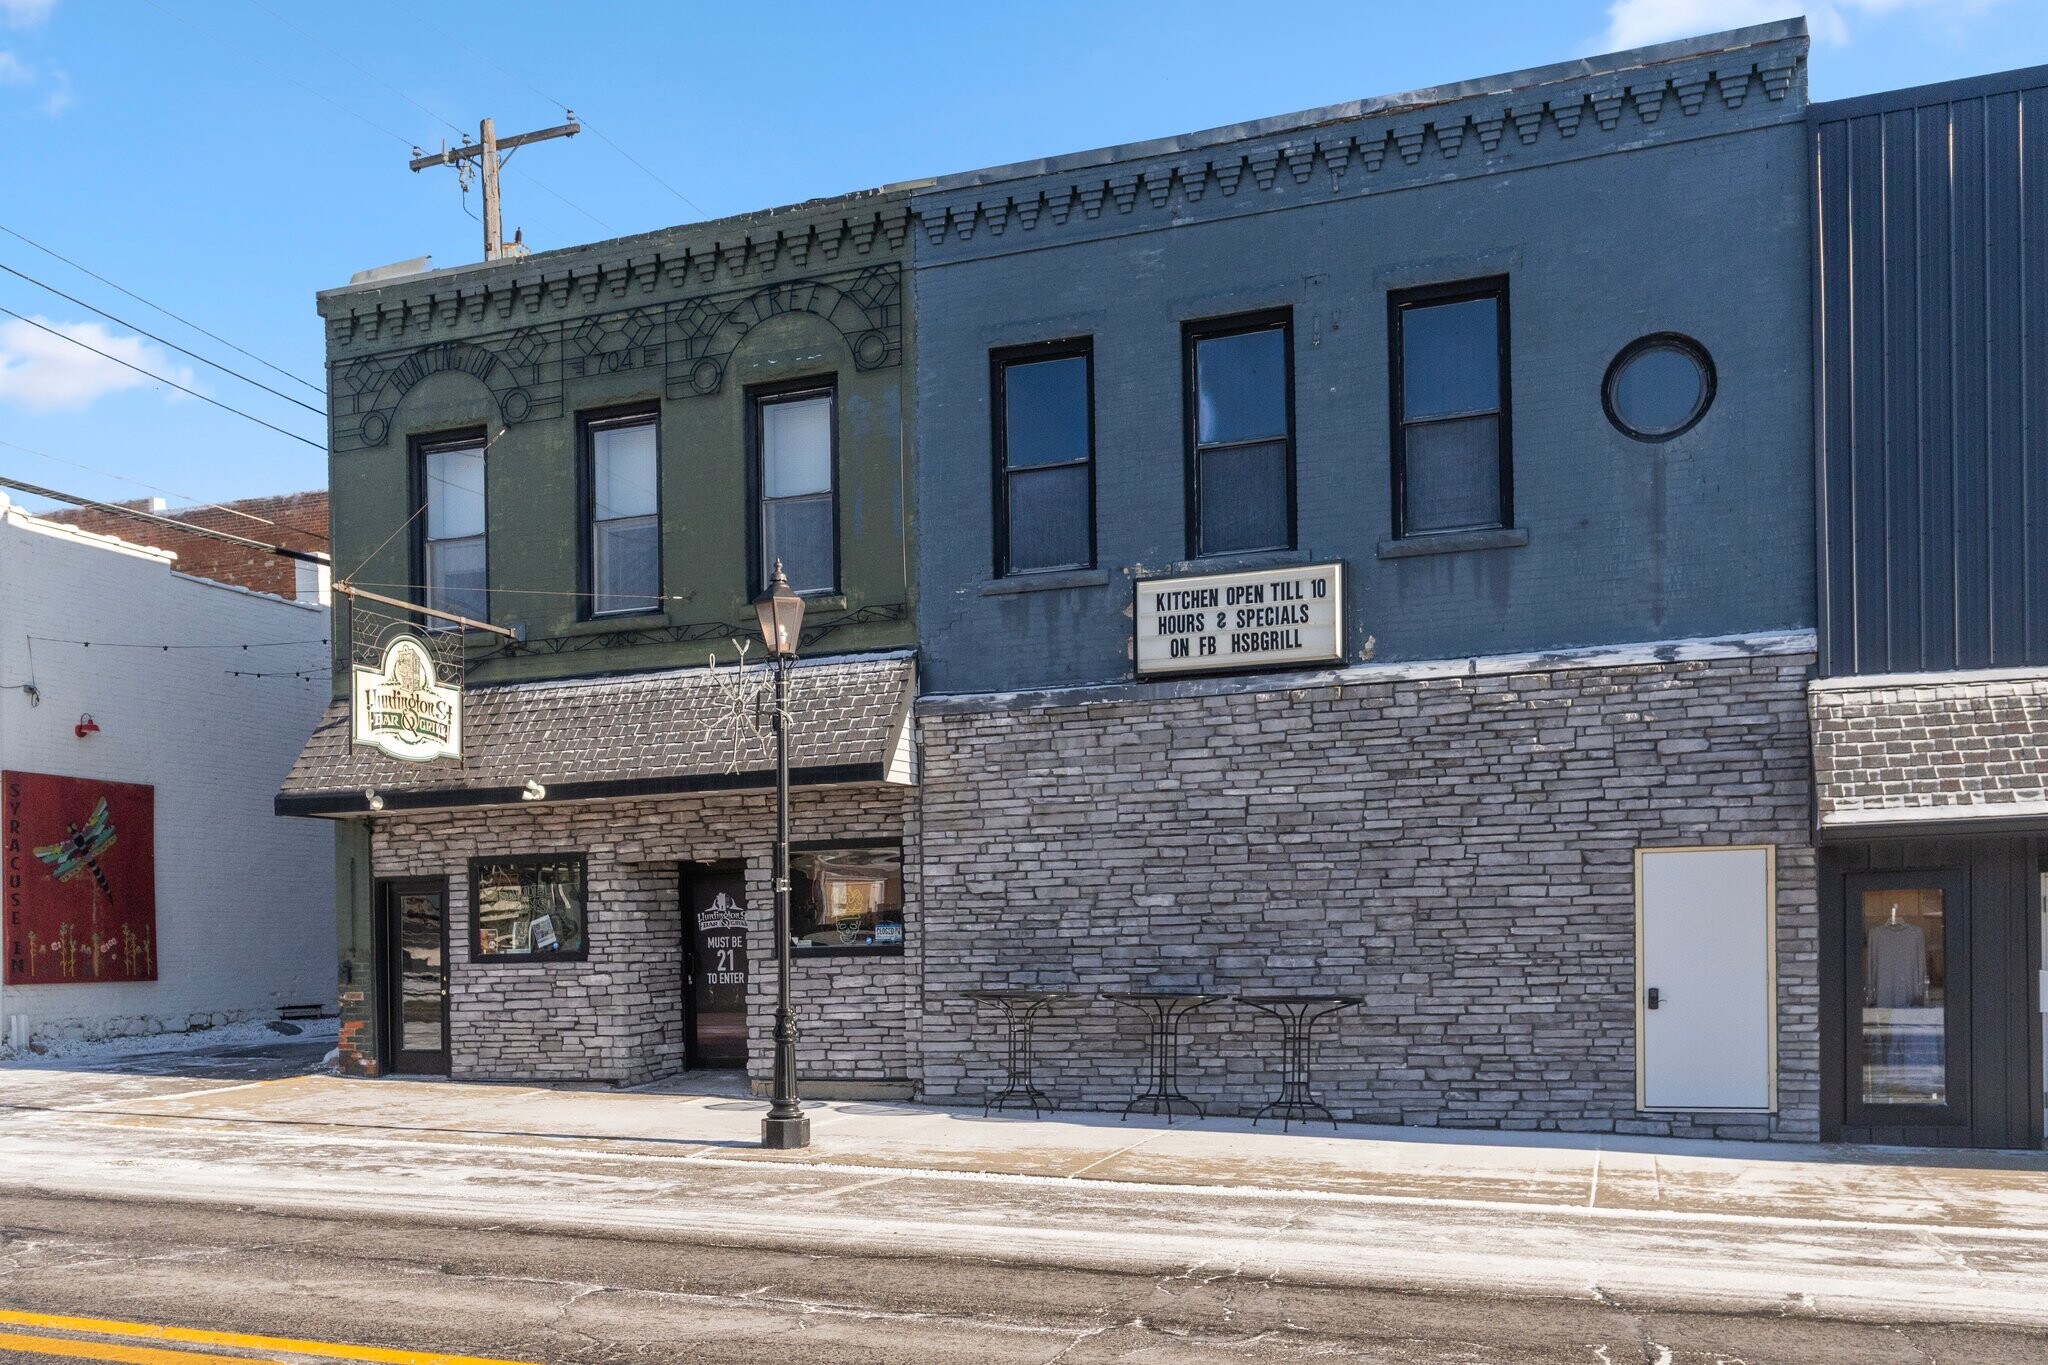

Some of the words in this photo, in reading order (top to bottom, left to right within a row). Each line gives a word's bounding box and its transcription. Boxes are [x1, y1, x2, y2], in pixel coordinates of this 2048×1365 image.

[598, 351, 634, 374] 704
[1156, 588, 1219, 612] KITCHEN
[1226, 584, 1264, 606] OPEN
[1271, 580, 1304, 602] TILL
[1311, 578, 1327, 599] 10
[1158, 612, 1205, 635] HOURS
[1236, 603, 1309, 629] SPECIALS
[1170, 637, 1190, 658] ON
[1199, 635, 1217, 656] FB
[1231, 628, 1303, 653] HSBGRILL
[365, 689, 435, 718] Huntington
[435, 700, 453, 725] St
[373, 713, 400, 728] BAR
[402, 708, 420, 737] &
[9, 783, 21, 926] SYRACUSE
[11, 941, 24, 974] IN
[707, 937, 730, 949] MUST
[731, 936, 743, 948] BE
[716, 949, 734, 972] 21
[707, 973, 718, 985] TO
[719, 972, 745, 984] ENTER
